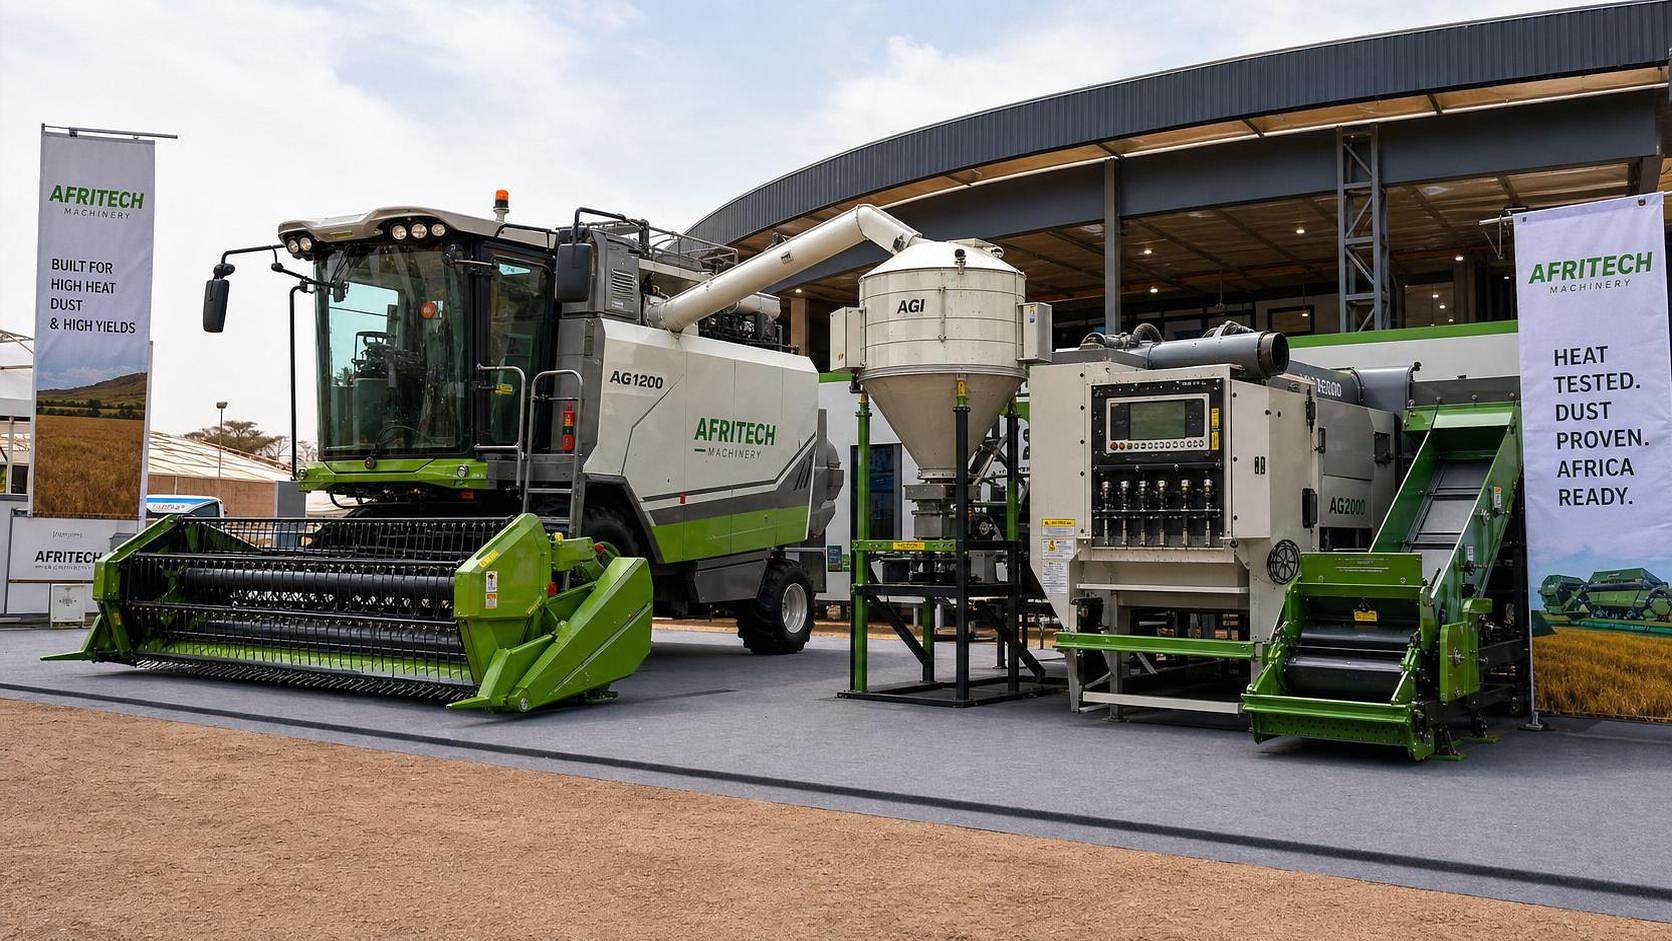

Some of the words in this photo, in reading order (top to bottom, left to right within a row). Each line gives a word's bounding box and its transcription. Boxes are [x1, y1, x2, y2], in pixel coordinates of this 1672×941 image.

[49, 185, 144, 209] AFRITECH
[64, 208, 130, 219] MACHINERY
[52, 258, 86, 272] BUILT
[89, 261, 113, 274] FOR
[1528, 251, 1652, 284] AFRITECH
[51, 278, 82, 292] HIGH
[86, 281, 116, 294] HEAT
[1549, 279, 1631, 294] MACHINERY
[50, 298, 83, 311] DUST
[897, 299, 925, 314] AGI
[49, 317, 60, 330] &
[63, 319, 93, 332] HIGH
[96, 320, 136, 333] YIELDS
[1554, 346, 1608, 366] HEAT
[609, 371, 664, 389] AG1200
[1553, 372, 1640, 393] TESTED.
[1555, 402, 1612, 421] DUST
[694, 417, 776, 446] AFRITECH
[1557, 429, 1649, 449] PROVEN.
[707, 447, 762, 459] MACHINERY
[1557, 458, 1634, 478] AFRICA
[1558, 487, 1633, 506] READY.
[1329, 497, 1366, 515] AG2000
[35, 551, 102, 563] AFRITECH
